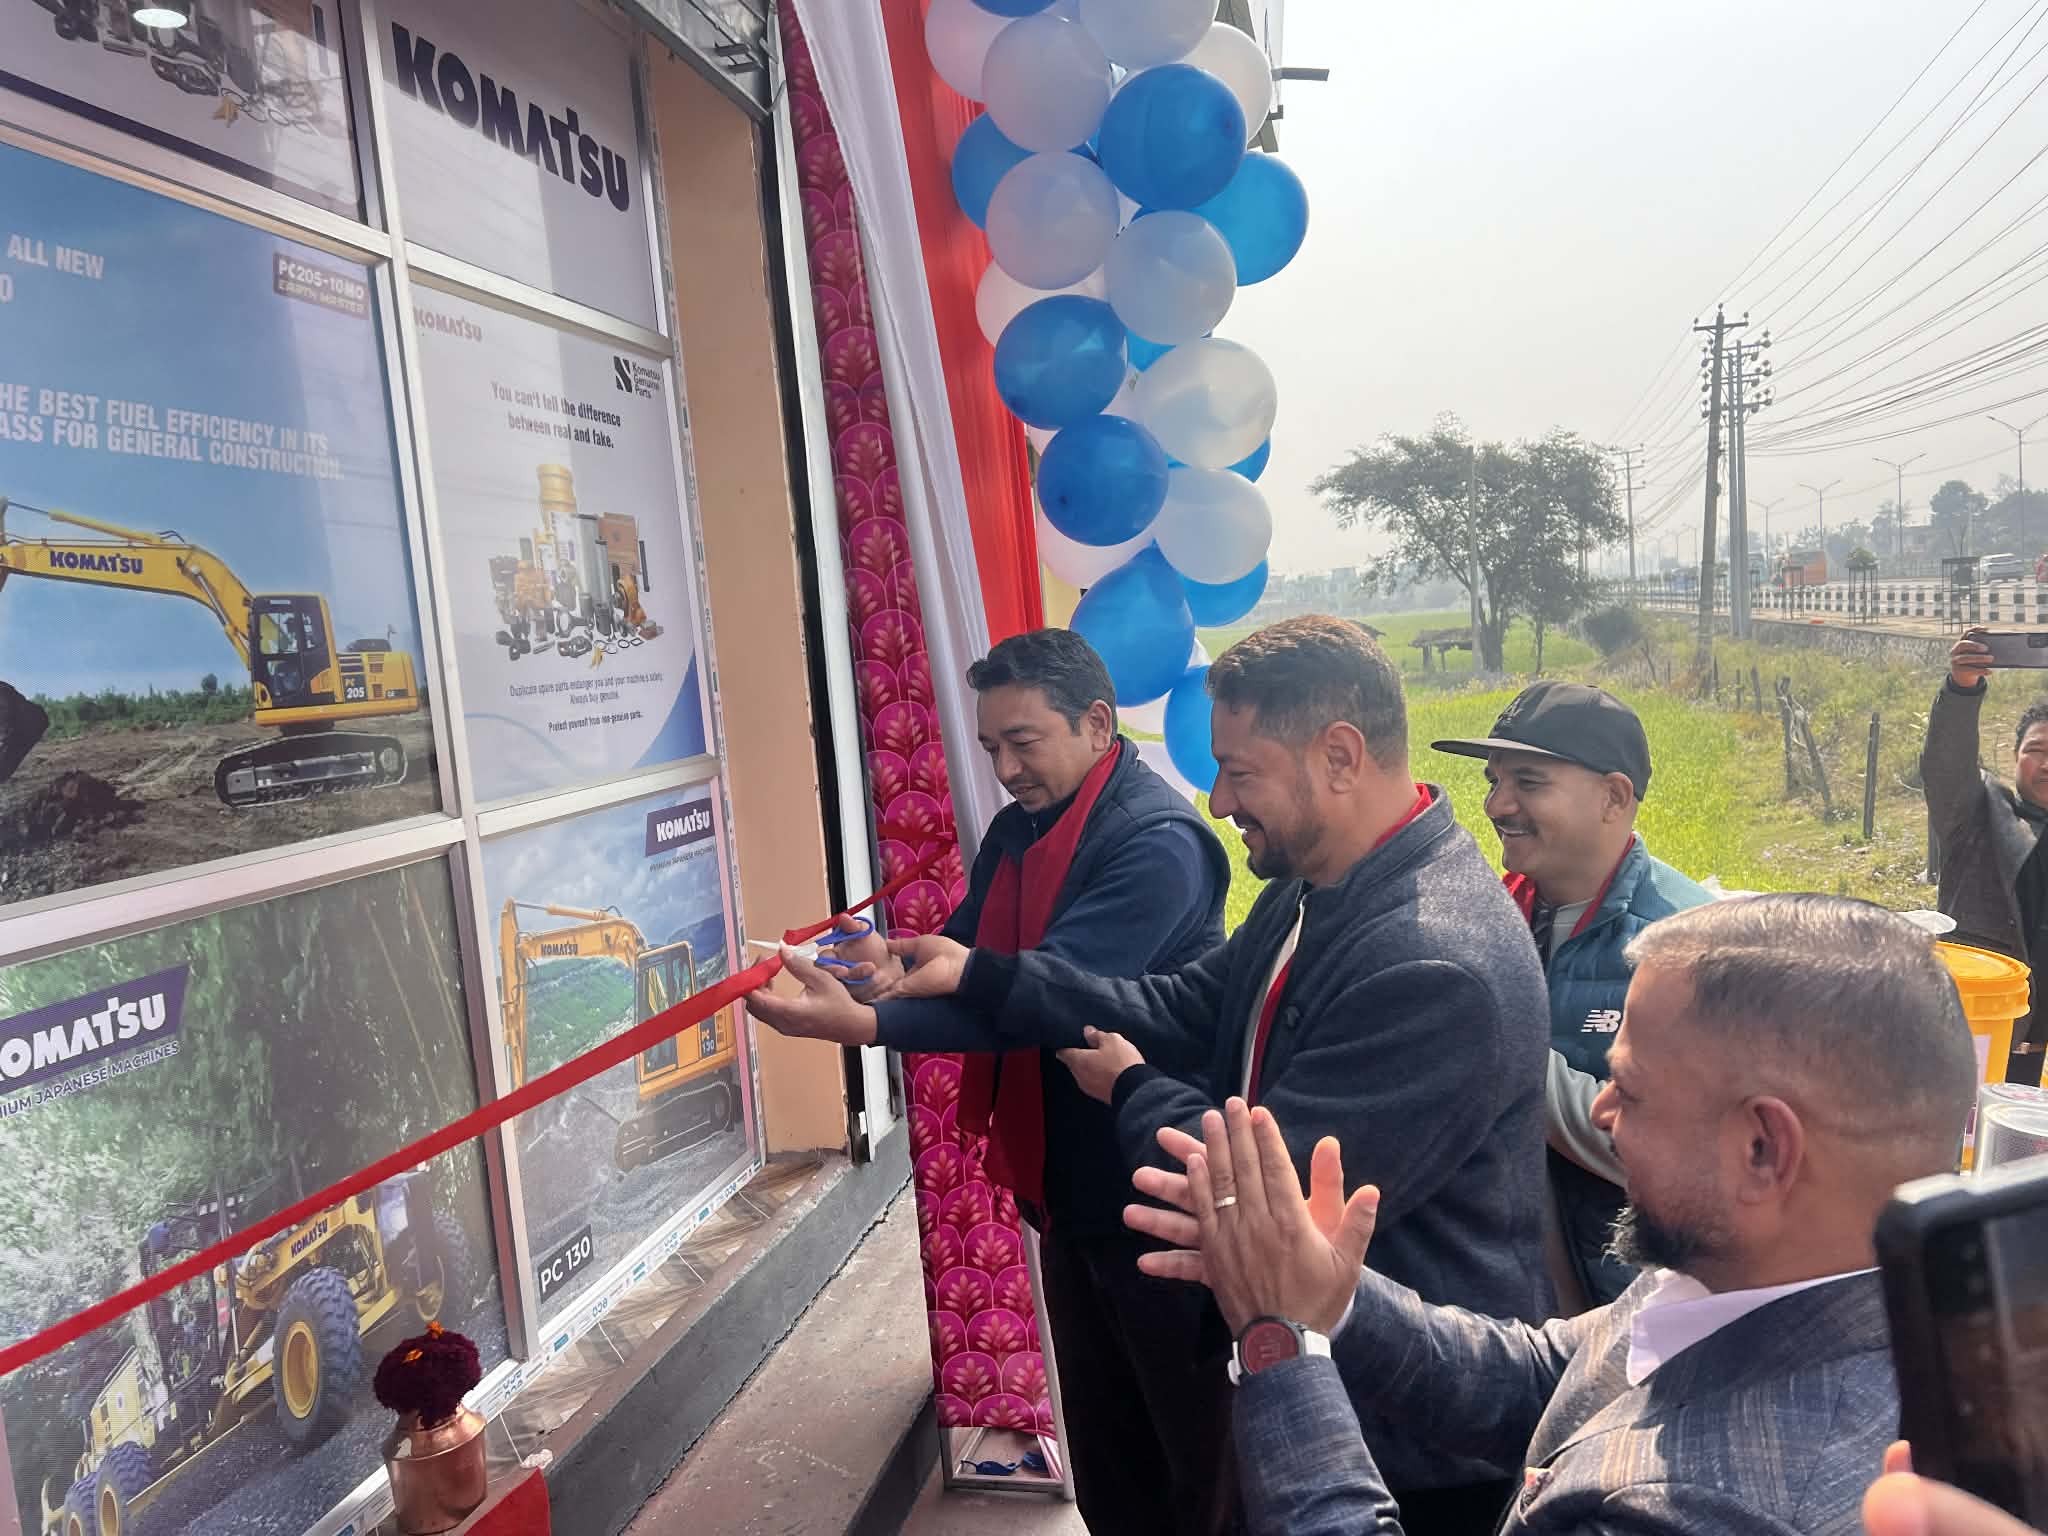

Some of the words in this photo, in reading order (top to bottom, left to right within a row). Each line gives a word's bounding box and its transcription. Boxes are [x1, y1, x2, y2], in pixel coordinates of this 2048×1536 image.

[392, 21, 630, 212] KOMATSU
[7, 233, 48, 267] ALL
[55, 245, 104, 280] NEW
[413, 306, 482, 342] KOMATSU
[40, 389, 98, 421] BEST
[106, 399, 159, 430] FUEL
[167, 408, 273, 447] EFFICIENCY
[280, 427, 296, 450] IN
[304, 432, 328, 455] ITS
[491, 381, 512, 402] You
[514, 390, 541, 409] can't
[560, 397, 576, 417] the
[577, 401, 622, 427] difference
[53, 418, 98, 449] FOR
[107, 425, 203, 462] GENERAL
[507, 411, 551, 436] between
[552, 423, 572, 440] real
[573, 427, 591, 443] and
[592, 428, 614, 448] fake.
[50, 550, 143, 575] KOMATSU
[346, 687, 365, 699] 205
[656, 808, 710, 842] KOMATSU
[541, 940, 578, 956] KOMATSU
[0, 993, 166, 1081] OMATSU
[36, 1068, 110, 1105] JAPANESE
[111, 1040, 180, 1076] MACHINES
[291, 1217, 328, 1258] KOMATSU
[541, 1258, 564, 1293] PC
[565, 1236, 591, 1271] 130
